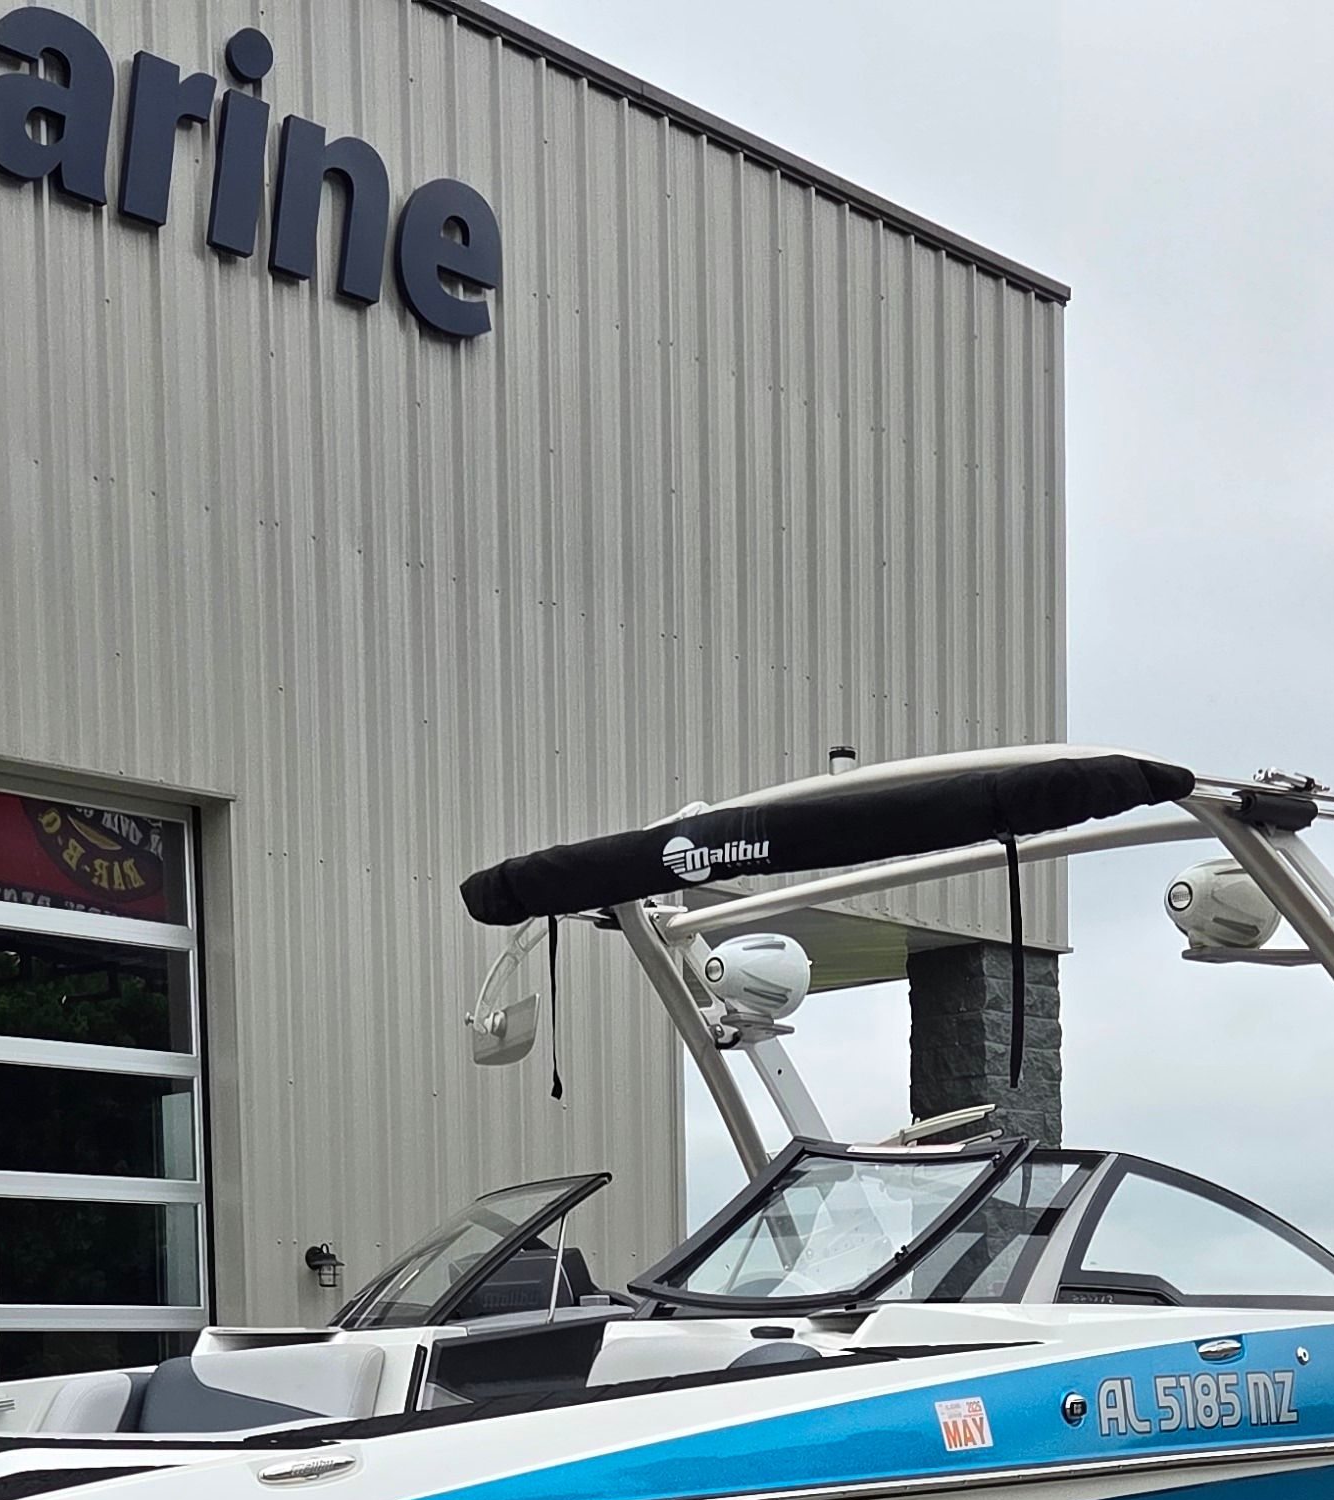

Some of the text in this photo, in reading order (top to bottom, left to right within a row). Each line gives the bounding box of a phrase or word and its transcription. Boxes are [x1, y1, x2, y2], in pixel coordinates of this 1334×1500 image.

[685, 839, 770, 872] Malibu
[1098, 1369, 1299, 1437] AL 5185 MZ
[943, 1416, 986, 1449] MAY
